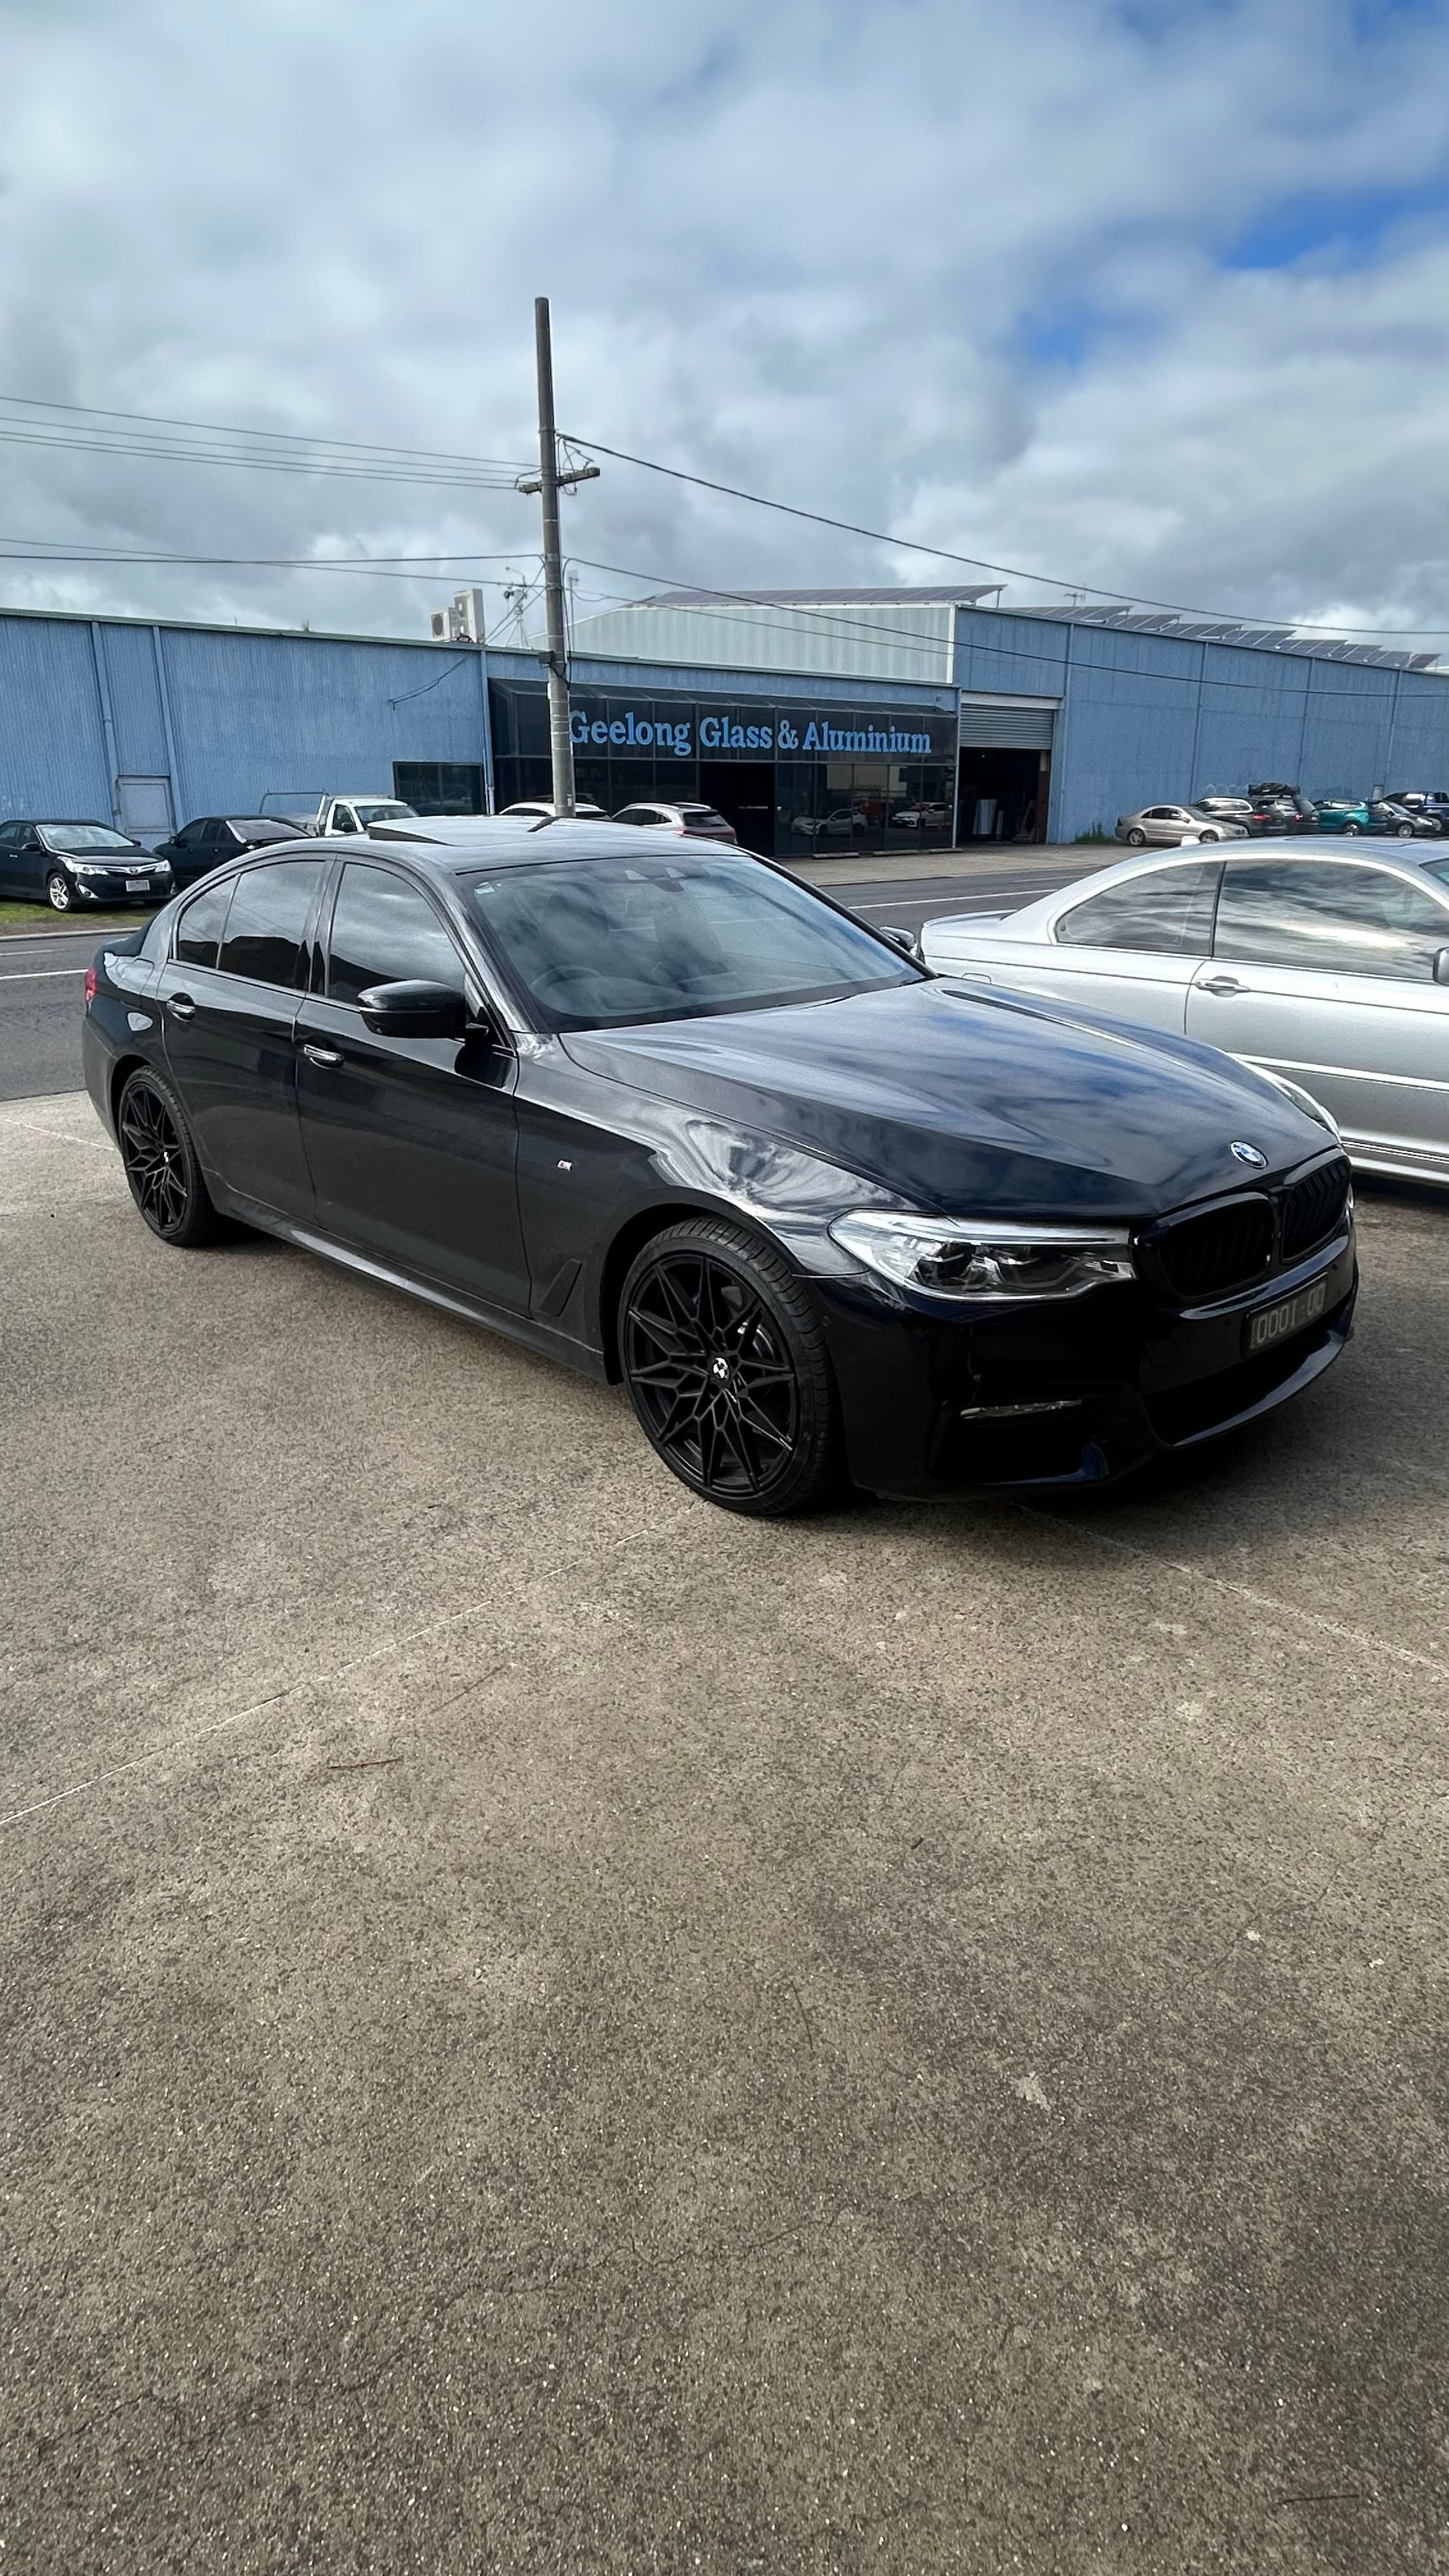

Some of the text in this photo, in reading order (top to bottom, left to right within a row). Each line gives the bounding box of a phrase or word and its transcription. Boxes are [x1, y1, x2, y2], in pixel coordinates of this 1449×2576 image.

[569, 710, 932, 756] Geelong Glass & Aluminium
